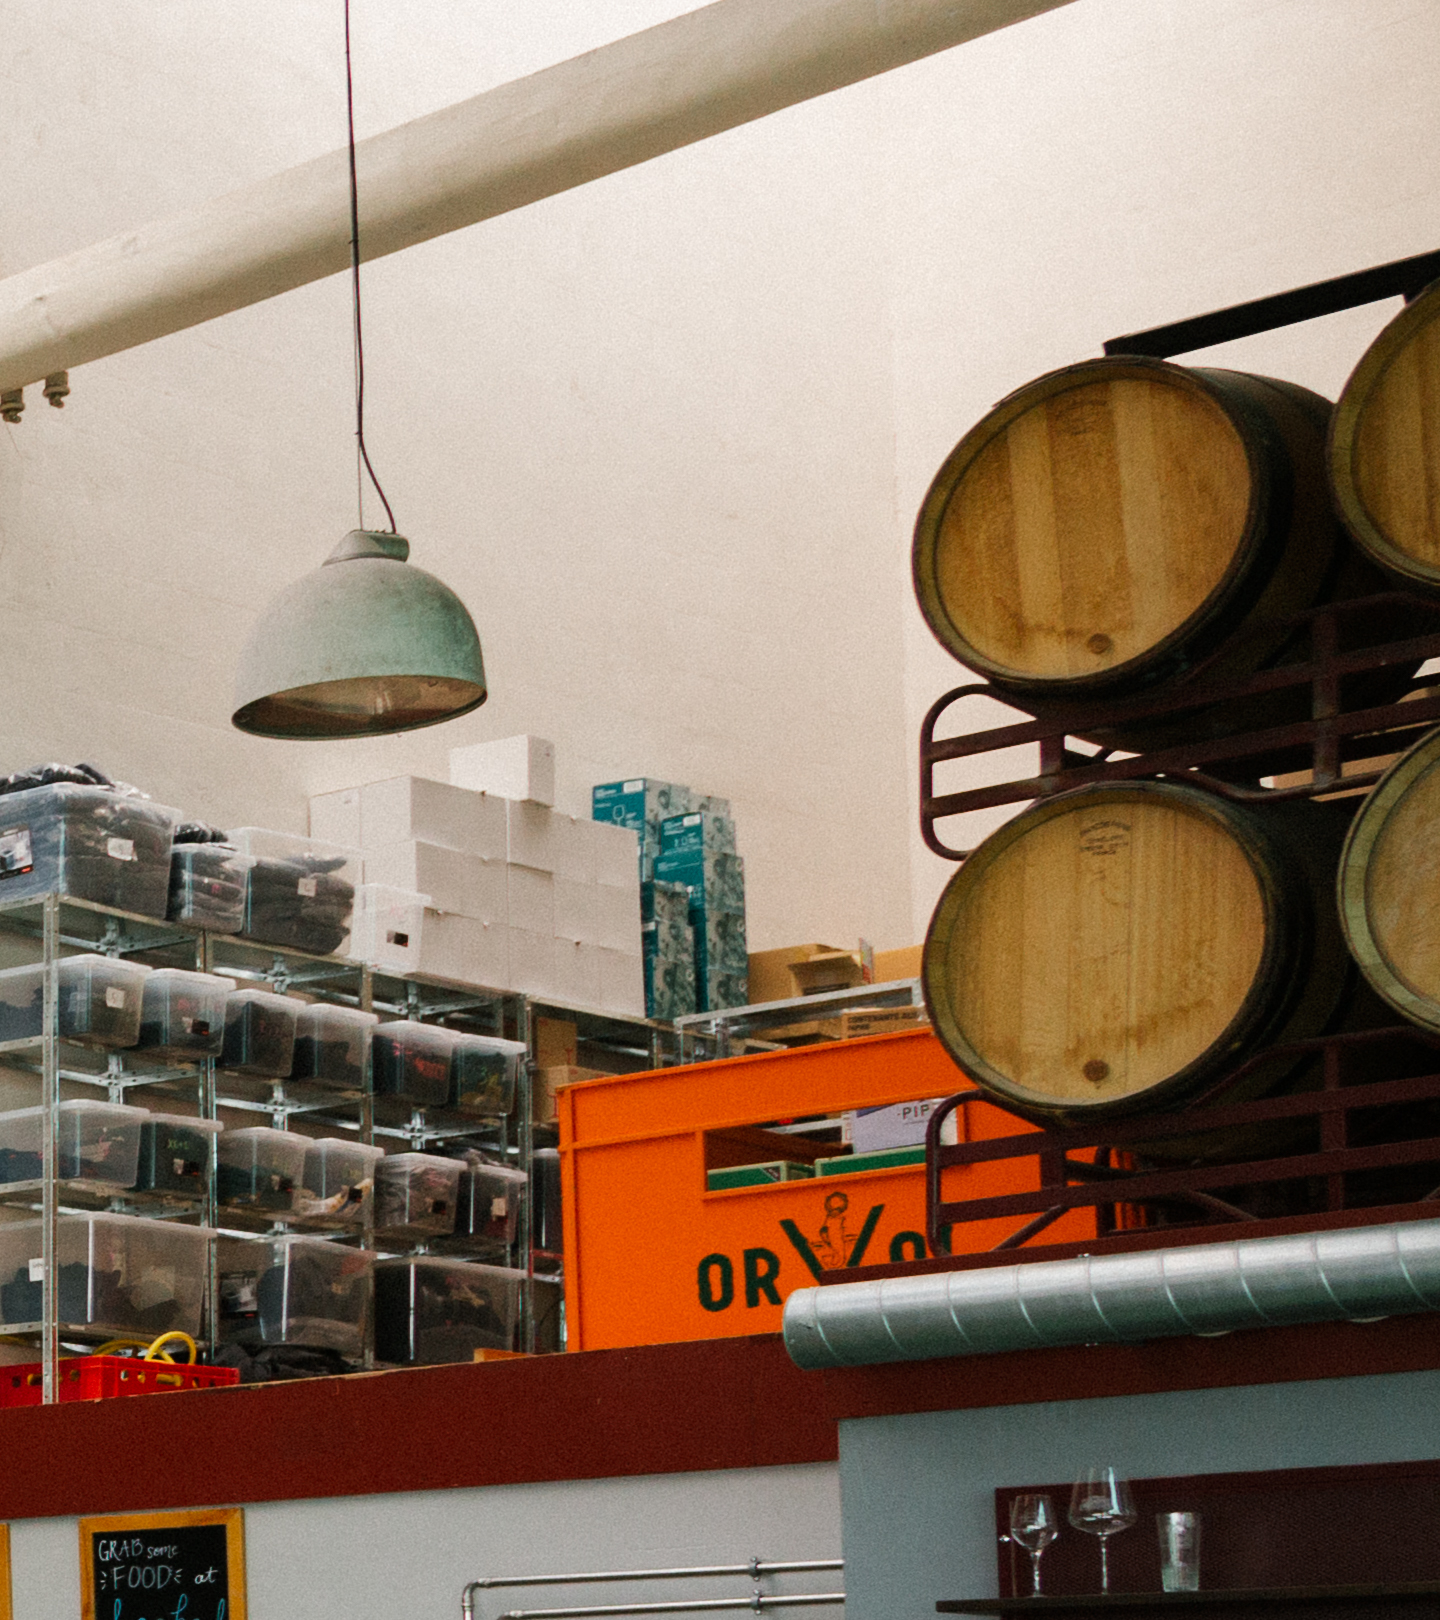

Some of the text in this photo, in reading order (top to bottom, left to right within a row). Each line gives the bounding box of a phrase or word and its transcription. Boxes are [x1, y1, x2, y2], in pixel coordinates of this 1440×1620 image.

[98, 1539, 179, 1562] GRAB some
[113, 1563, 219, 1591] FOOD at
